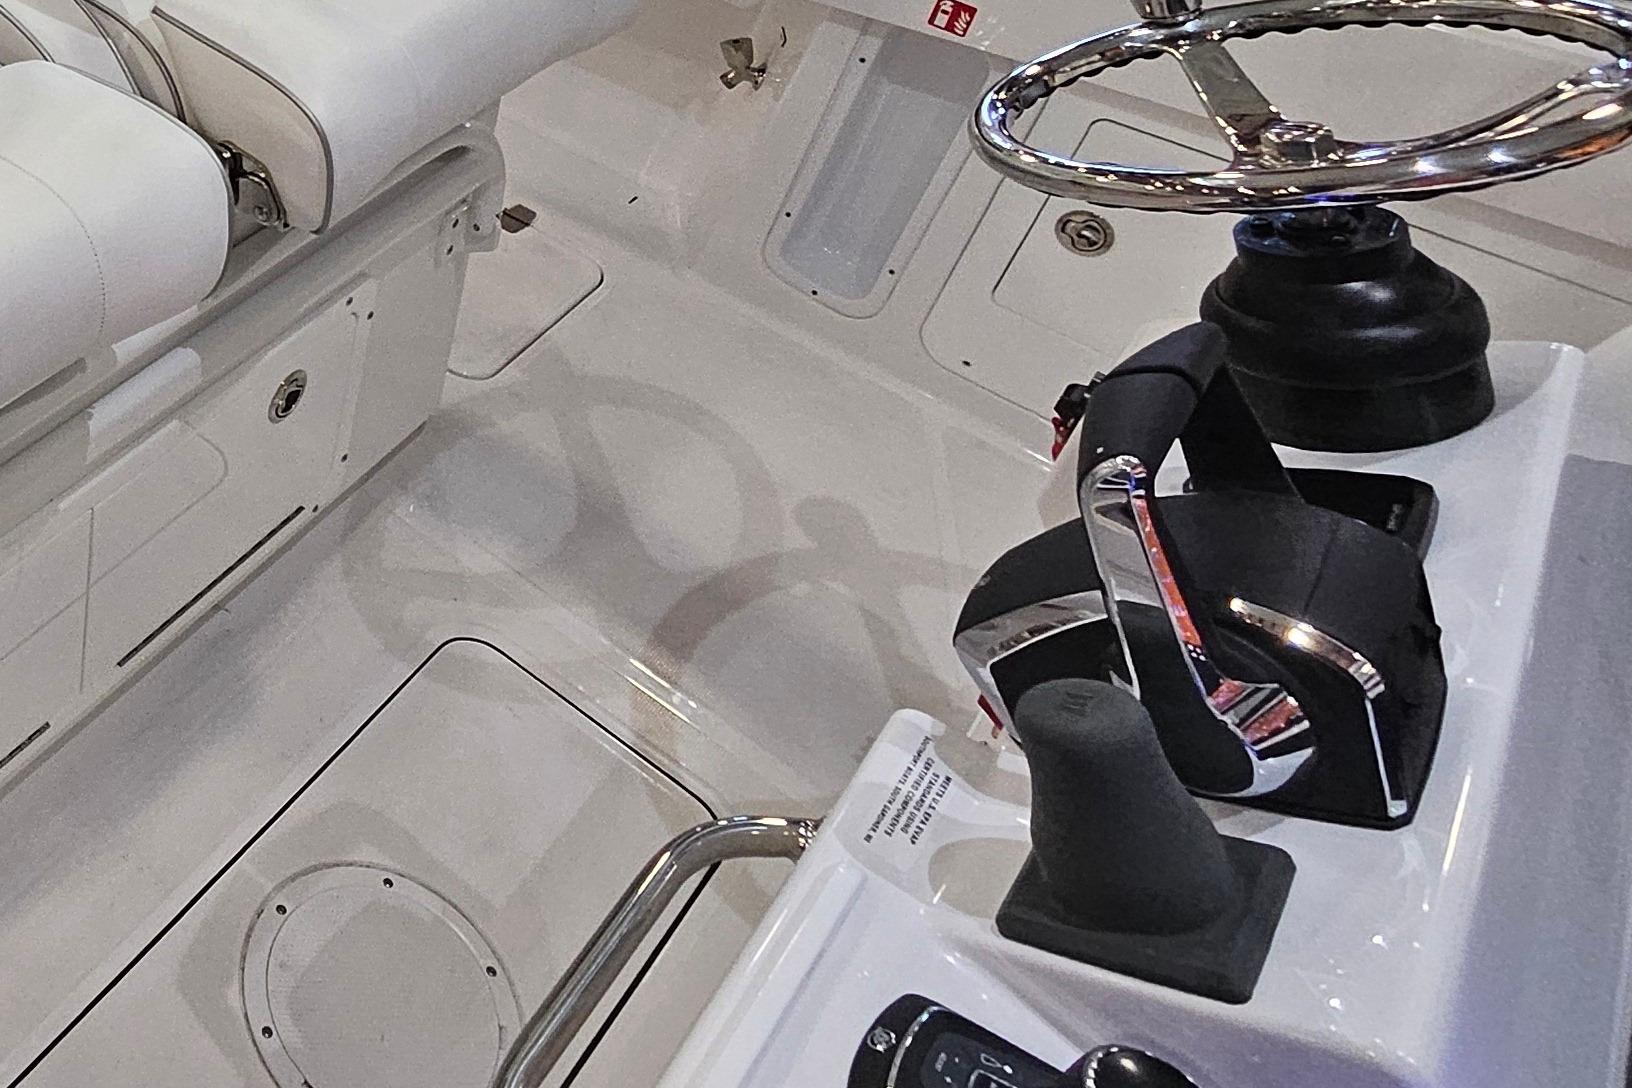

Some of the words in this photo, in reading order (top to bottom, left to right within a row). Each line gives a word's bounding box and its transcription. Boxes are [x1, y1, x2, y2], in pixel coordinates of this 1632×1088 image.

[910, 757, 935, 791] CERTIFIED
[913, 772, 940, 812] STANDARDS
[936, 775, 952, 798] MEETS
[884, 790, 915, 837] COMPONENTS
[900, 811, 918, 835] USING
[919, 811, 932, 826] EPA
[909, 825, 924, 845] EVAP
